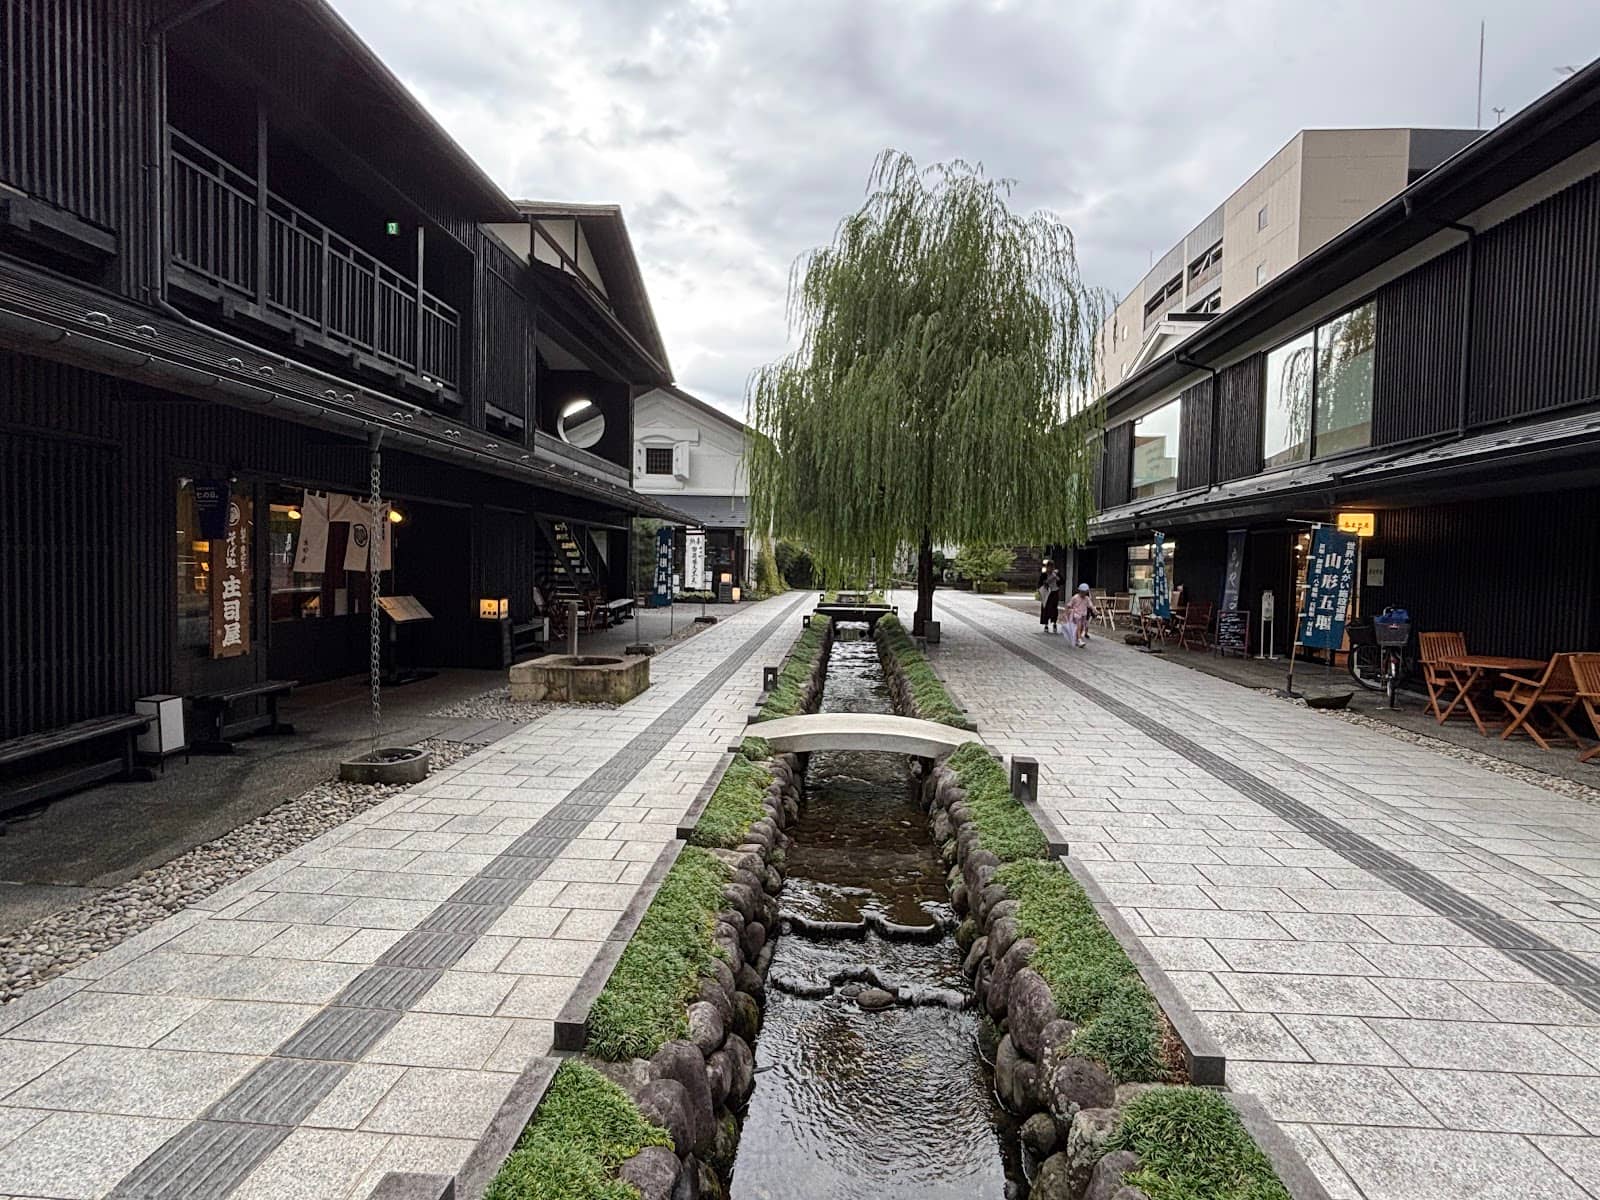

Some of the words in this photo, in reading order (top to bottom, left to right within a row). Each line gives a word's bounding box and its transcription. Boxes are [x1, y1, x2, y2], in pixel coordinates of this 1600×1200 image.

[226, 531, 238, 568] そば処
[222, 575, 241, 648] 庄司屋
[1315, 552, 1341, 630] 山形五堰
